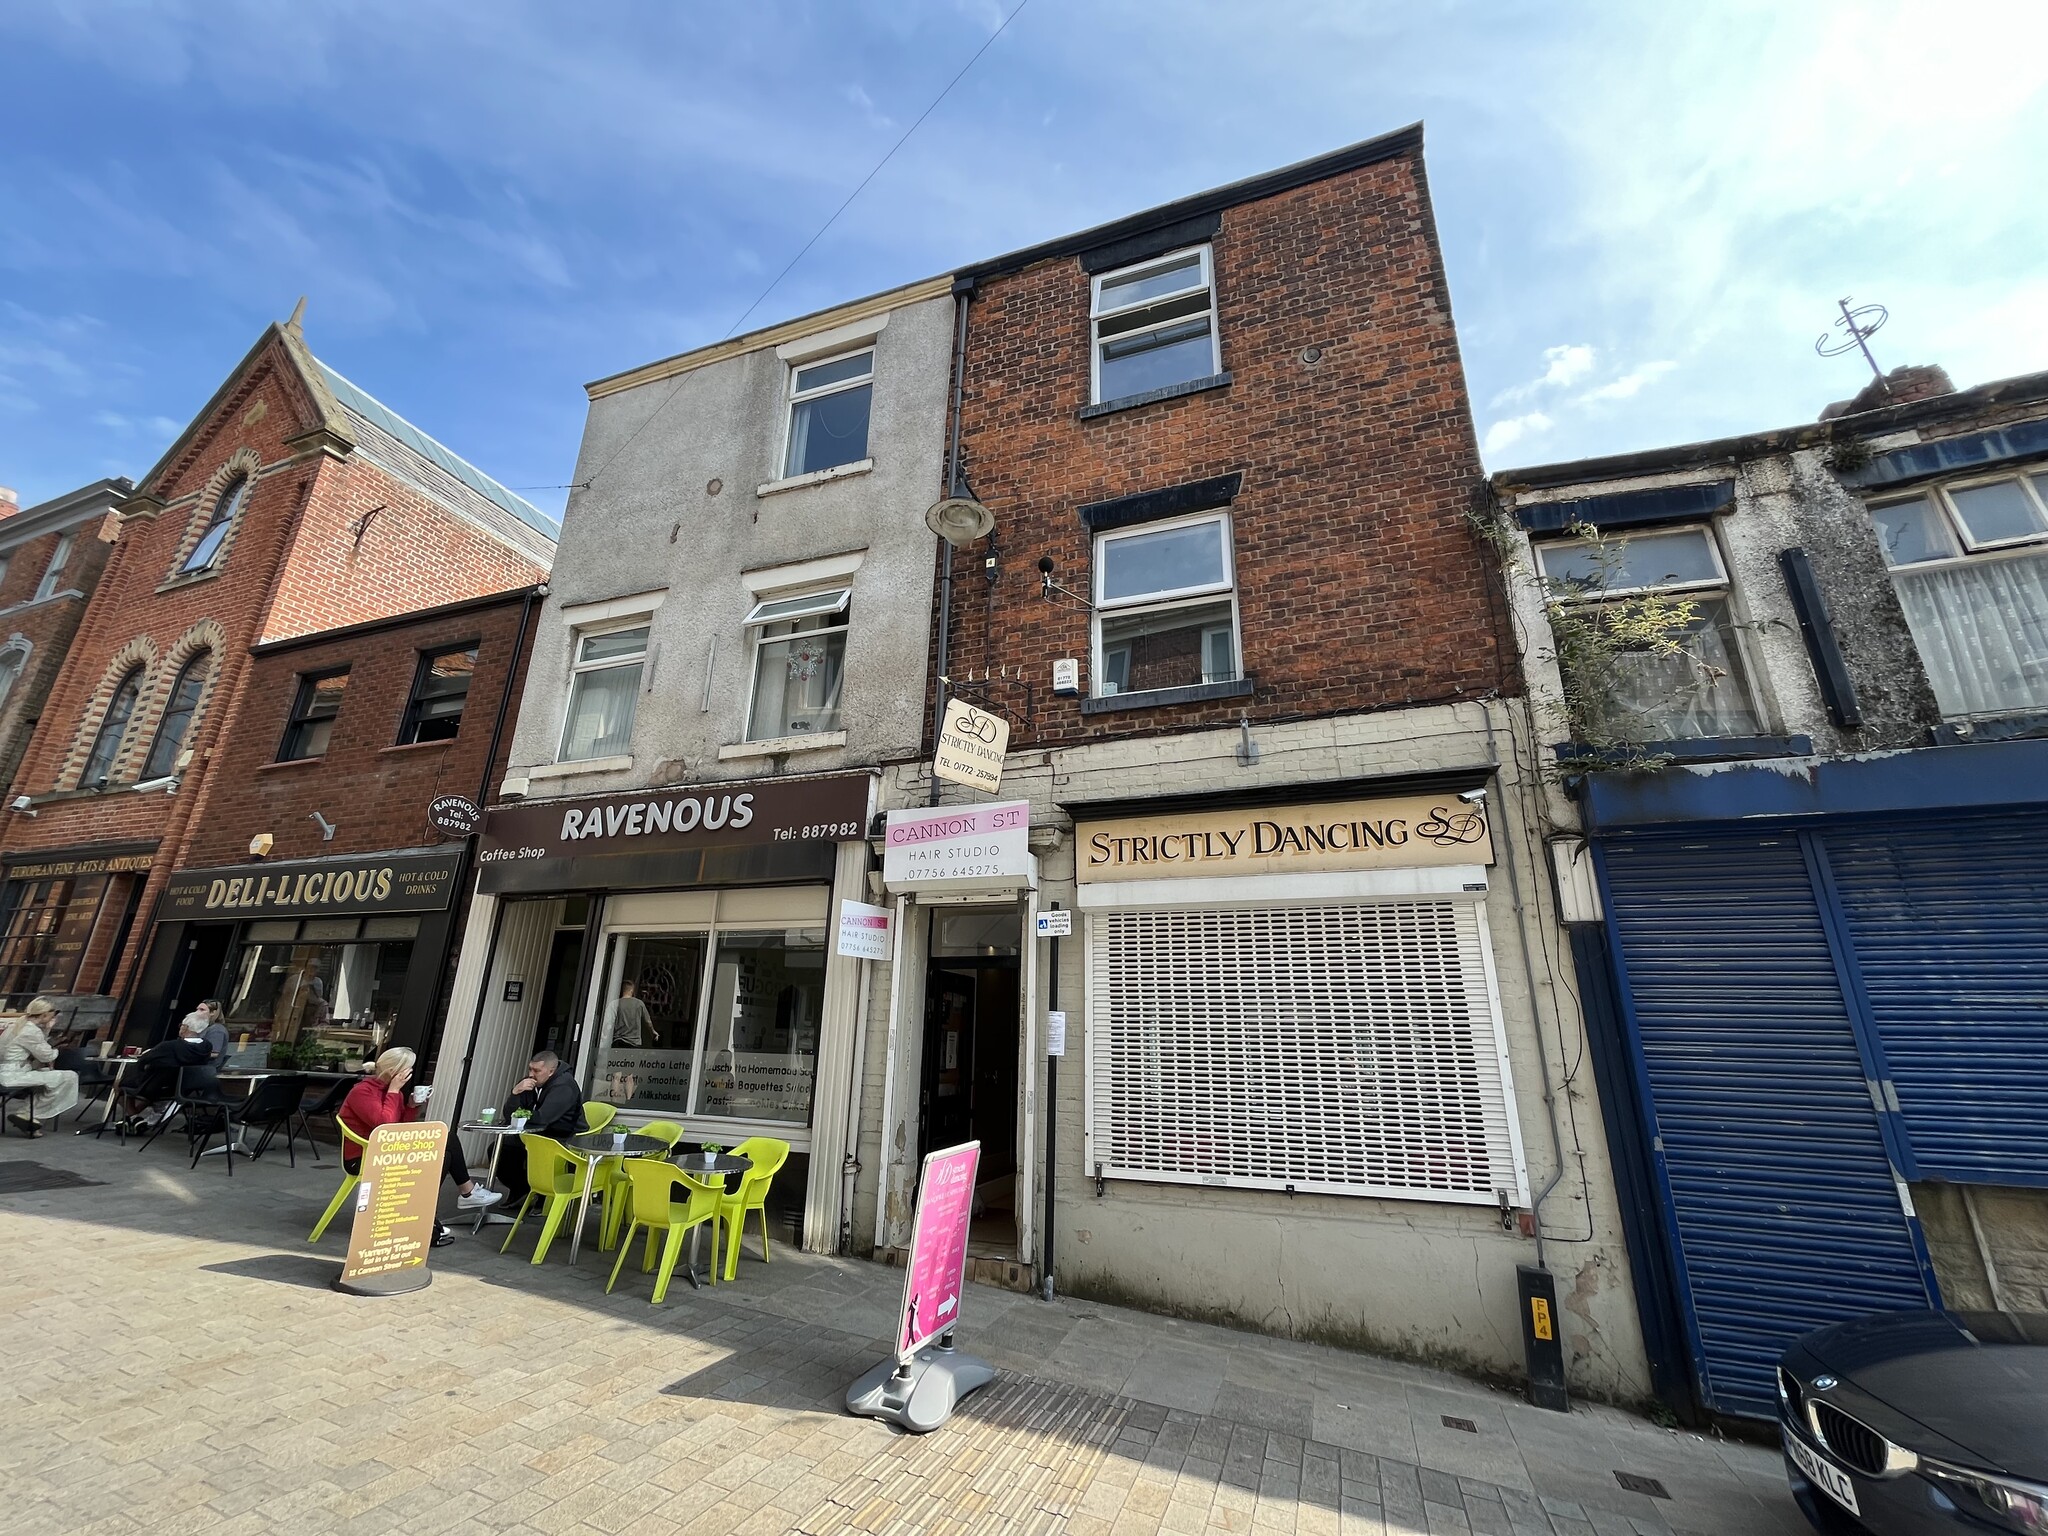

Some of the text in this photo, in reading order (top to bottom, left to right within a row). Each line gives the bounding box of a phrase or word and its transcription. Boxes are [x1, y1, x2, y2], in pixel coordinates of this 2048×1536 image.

[940, 733, 1004, 765] STRICTLY DANCING
[976, 769, 998, 782] 257994
[433, 798, 480, 821] RAVENOUS
[449, 809, 464, 820] Tel:
[437, 816, 471, 831] 887982
[560, 793, 755, 842] RAVENOUS
[773, 822, 858, 842] Tel: 887982
[892, 810, 1020, 843] CANNON ST
[1090, 818, 1408, 865] STRICTLY DANCING
[480, 846, 546, 862] Coffee Shop
[909, 845, 1000, 861] HAIR STUDIO
[10, 863, 54, 878] EUROPEAN
[54, 862, 75, 875] FINE
[75, 860, 98, 873] ARTS
[106, 855, 153, 871] ANTIQUES
[908, 864, 999, 880] 07756 645275
[398, 870, 448, 882] HOT & COLD
[169, 887, 184, 896] HOT
[188, 884, 207, 895] COLD
[205, 867, 393, 908] DELI-LICIOUS
[405, 884, 438, 895] DRINKS
[175, 896, 195, 906] FOOD
[841, 916, 872, 926] CANNON
[842, 930, 885, 943] HAIR STUDIO
[639, 1059, 665, 1069] Mocha
[669, 1060, 690, 1070] Latte
[647, 1076, 687, 1086] Smoothies
[738, 1081, 783, 1093] Baguettes
[639, 1090, 680, 1101] Milkshakes
[377, 1129, 442, 1142] Ravenous
[381, 1140, 435, 1152] Coffee Shop
[372, 1150, 438, 1166] NOW OPEN
[358, 1240, 421, 1259] Yummy Treats
[373, 1238, 392, 1247] Loads
[363, 1257, 375, 1265] Eat
[401, 1250, 412, 1259] out
[357, 1265, 383, 1275] Cannon
[383, 1261, 403, 1271] Street
